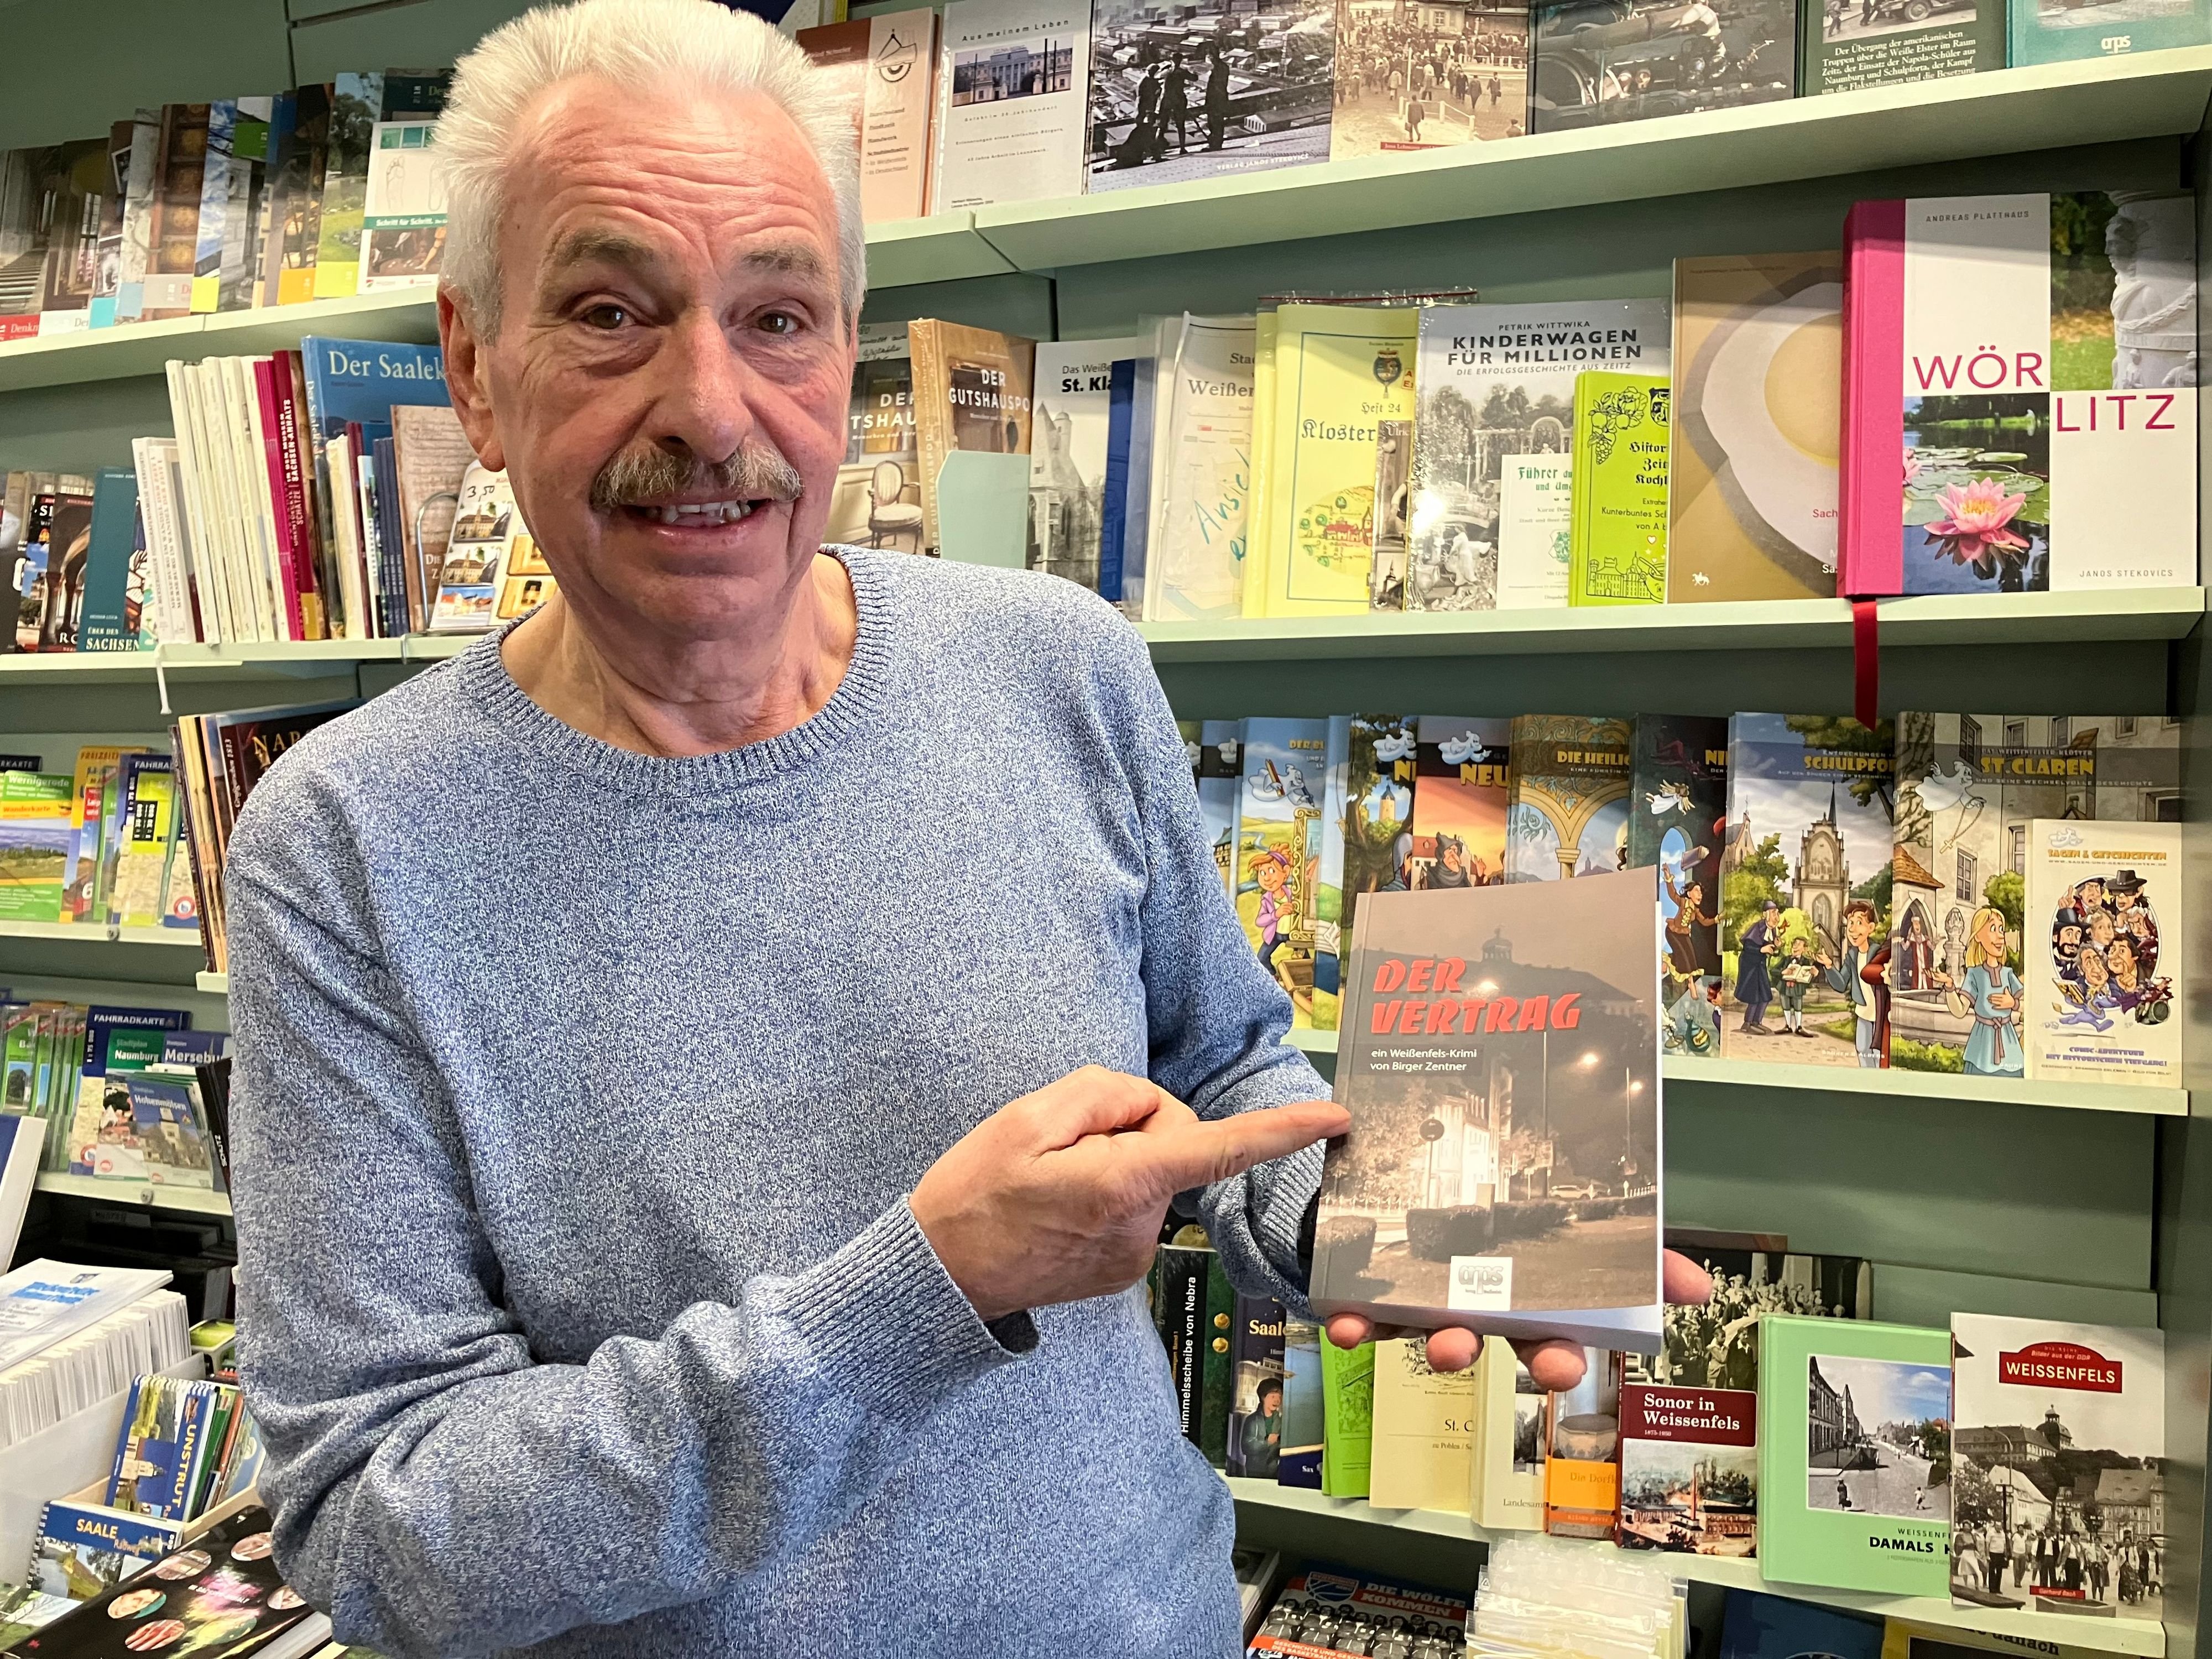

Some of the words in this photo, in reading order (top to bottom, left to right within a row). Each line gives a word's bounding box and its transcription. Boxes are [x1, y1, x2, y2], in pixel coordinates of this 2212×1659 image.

[987, 27, 1029, 38] meinem
[1035, 19, 1068, 30] Leben
[1835, 48, 1849, 56] Der
[1851, 42, 1887, 54] Übergang
[1889, 39, 1902, 48] der
[1903, 31, 1963, 46] amerikanischen
[1822, 57, 1854, 67] Truppen
[1857, 54, 1873, 62] über
[1876, 51, 1887, 59] die
[1890, 47, 1914, 57] Weiße
[1916, 44, 1938, 54] Elster
[1940, 41, 1950, 50] im
[1953, 39, 1976, 48] Raum
[1844, 65, 1856, 74] der
[1859, 61, 1885, 71] Einsatz
[1887, 58, 1900, 66] der
[1902, 49, 1960, 65] Napola-Schüler
[1963, 48, 1976, 56] aus
[1825, 73, 1865, 85] Naumburg
[1867, 70, 1882, 79] und
[1932, 61, 1945, 70] der
[1947, 56, 1974, 67] Kampf
[1850, 77, 1903, 90] Flakstellungen
[1906, 74, 1921, 83] und
[1923, 71, 1934, 80] die
[1217, 163, 1244, 171] VERLAG
[1926, 213, 1970, 222] ANDREAS
[1974, 210, 2029, 220] PLATTHAUS
[1499, 323, 1532, 331] PETRIK
[1537, 321, 1590, 330] WITTWIKA
[1453, 329, 1637, 349] KINDERWAGEN
[328, 350, 371, 377] Der
[1448, 349, 1492, 366] FÜR
[1505, 345, 1641, 364] MILLIONEN
[1062, 366, 1079, 374] Das
[1082, 363, 1112, 373] Weiße
[1476, 364, 1578, 375] ERFOLGSGESCHICHTE
[1580, 363, 1599, 371] AUS
[1603, 362, 1631, 370] ZEITZ
[1912, 346, 2043, 390] WÖR
[981, 369, 1006, 387] DER
[1062, 378, 1083, 392] St.
[948, 388, 1030, 412] GUTSHAUSPO
[1361, 402, 1383, 414] Heft
[1388, 403, 1401, 413] 24
[2056, 394, 2176, 432] LITZ
[1302, 419, 1376, 441] Kloster
[284, 399, 299, 482] SACHSEN-ANHALTS
[1518, 467, 1558, 479] Führer
[467, 486, 495, 502] 3,50
[1536, 482, 1550, 491] und
[1601, 507, 1652, 517] Kunterbuntes
[1812, 509, 1838, 518] Sach
[2079, 570, 2112, 578] JANOS
[2117, 568, 2173, 578] STEKOVICS
[86, 638, 139, 651] SACHSEN
[1289, 739, 1309, 750] DER
[1557, 750, 1582, 764] DIE
[2011, 757, 2094, 775] CLAREN
[9, 775, 70, 787] Wernigerode
[1373, 957, 1467, 993] DER
[94, 1014, 165, 1026] FAHRRADKARTE
[1371, 993, 1582, 1035] VERTRAG
[115, 1050, 159, 1063] Naumburg
[1371, 1048, 1387, 1058] ein
[1390, 1048, 1477, 1058] Weißenfels-Krimi
[1370, 1062, 1390, 1071] von
[1392, 1061, 1423, 1073] Birger
[1425, 1061, 1467, 1071] Zentner
[134, 1094, 187, 1110] Hohenmölsen
[1458, 1265, 1504, 1294] arps
[1185, 1277, 1196, 1311] Nebra
[1186, 1315, 1194, 1337] von
[2006, 1361, 2116, 1384] WEISSENFELS
[1181, 1339, 1193, 1433] Himmelsscheibe
[1644, 1393, 1694, 1410] Sonor
[1699, 1397, 1715, 1411] in
[1445, 1418, 1459, 1431] St.
[1643, 1410, 1740, 1431] Weissenfels
[172, 1424, 197, 1509] UNSTRUT
[76, 1519, 119, 1539] SAALE
[1870, 1536, 1934, 1553] DAMALS
[1365, 1583, 1398, 1596] DIE
[1402, 1589, 1467, 1608] WÖLFE
[1360, 1593, 1452, 1618] KOMMEN
[1274, 1640, 1320, 1653] GESCHICHTE
[1320, 1648, 1336, 1657] UND
